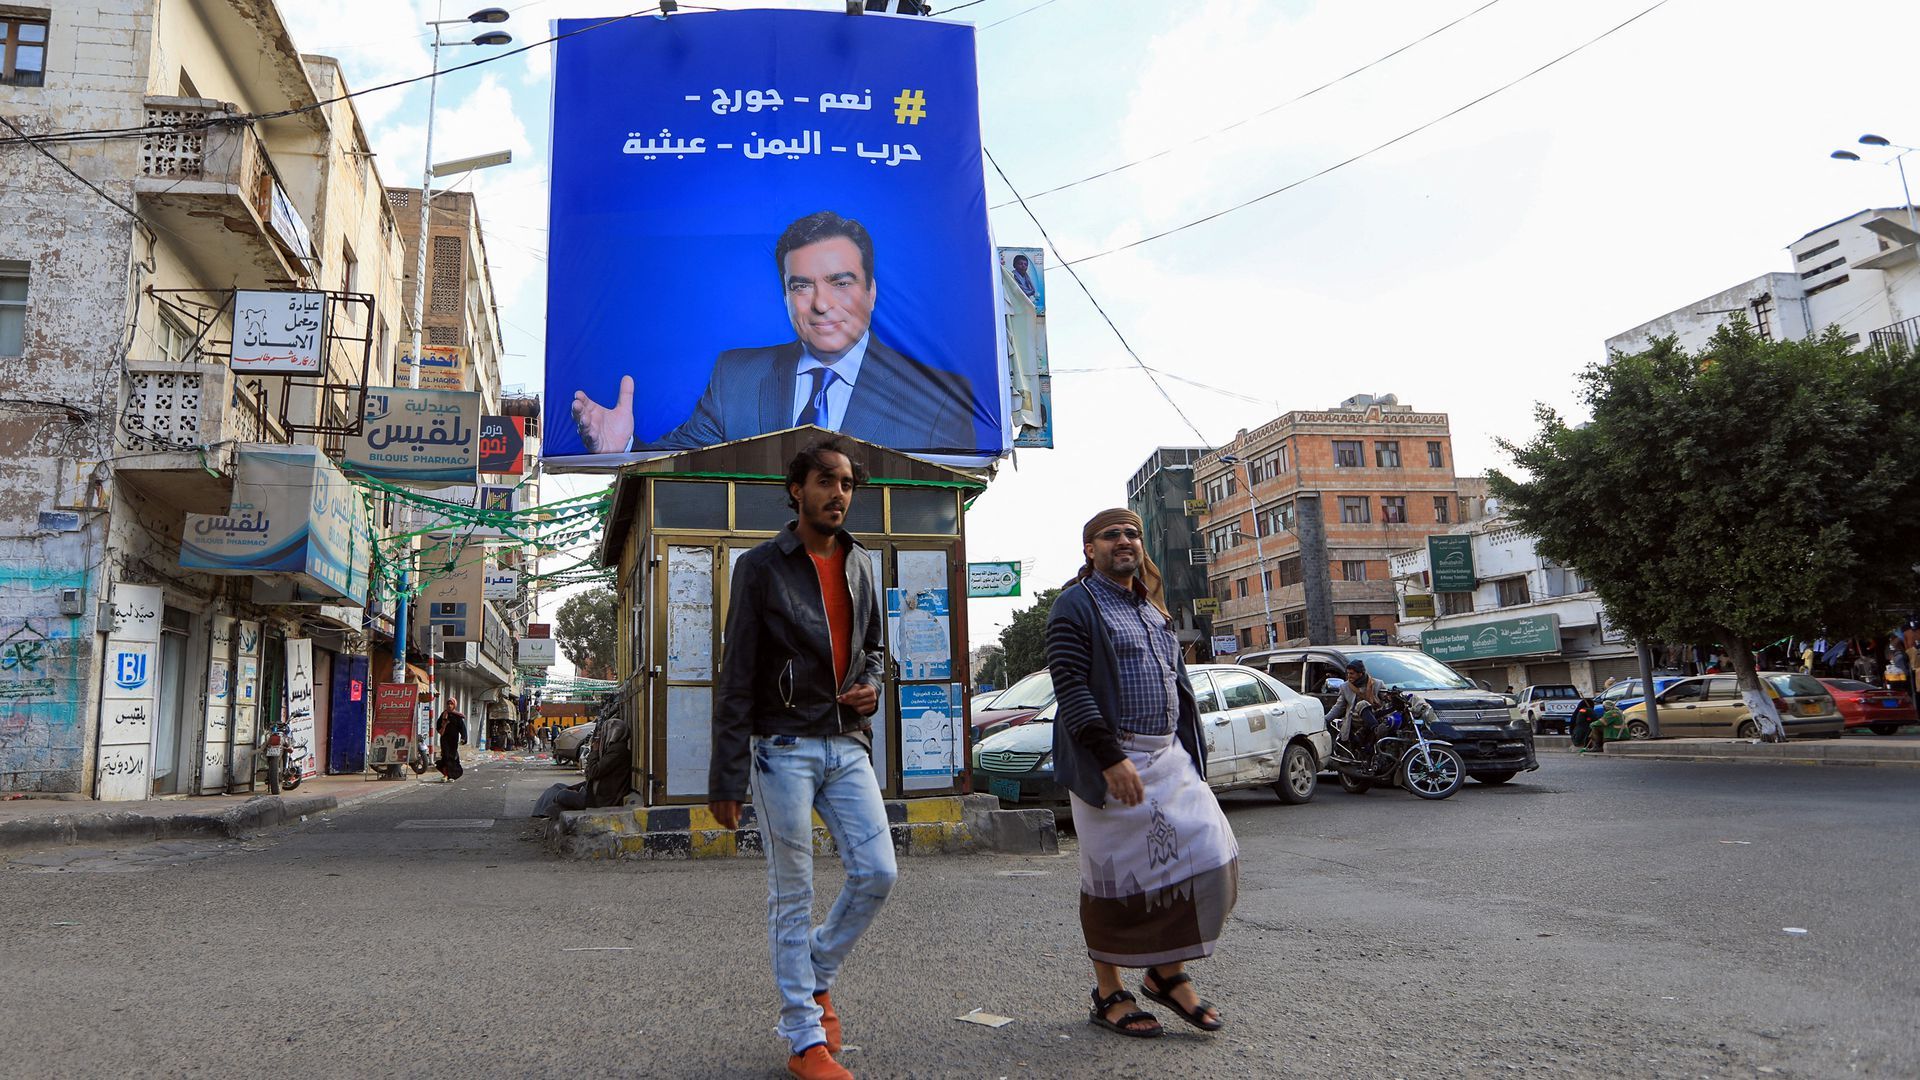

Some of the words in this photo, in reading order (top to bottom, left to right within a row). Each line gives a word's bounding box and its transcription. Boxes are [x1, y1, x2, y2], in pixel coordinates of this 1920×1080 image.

[711, 88, 784, 115] جورج
[819, 88, 872, 113] نعم
[622, 128, 706, 160] عبثية
[743, 130, 821, 160] اليمن
[856, 142, 921, 167] حرب
[289, 294, 319, 314] عيادة
[285, 313, 318, 331] ومعمل
[244, 332, 313, 350] الاسنان
[405, 398, 461, 415] صيدلية
[367, 416, 471, 454] بلقيس
[369, 453, 409, 463] BILQUIS
[413, 455, 469, 465] PHARMACY
[195, 511, 269, 538] بلقيس
[381, 687, 412, 698] باريس
[115, 705, 146, 724] بلقيس
